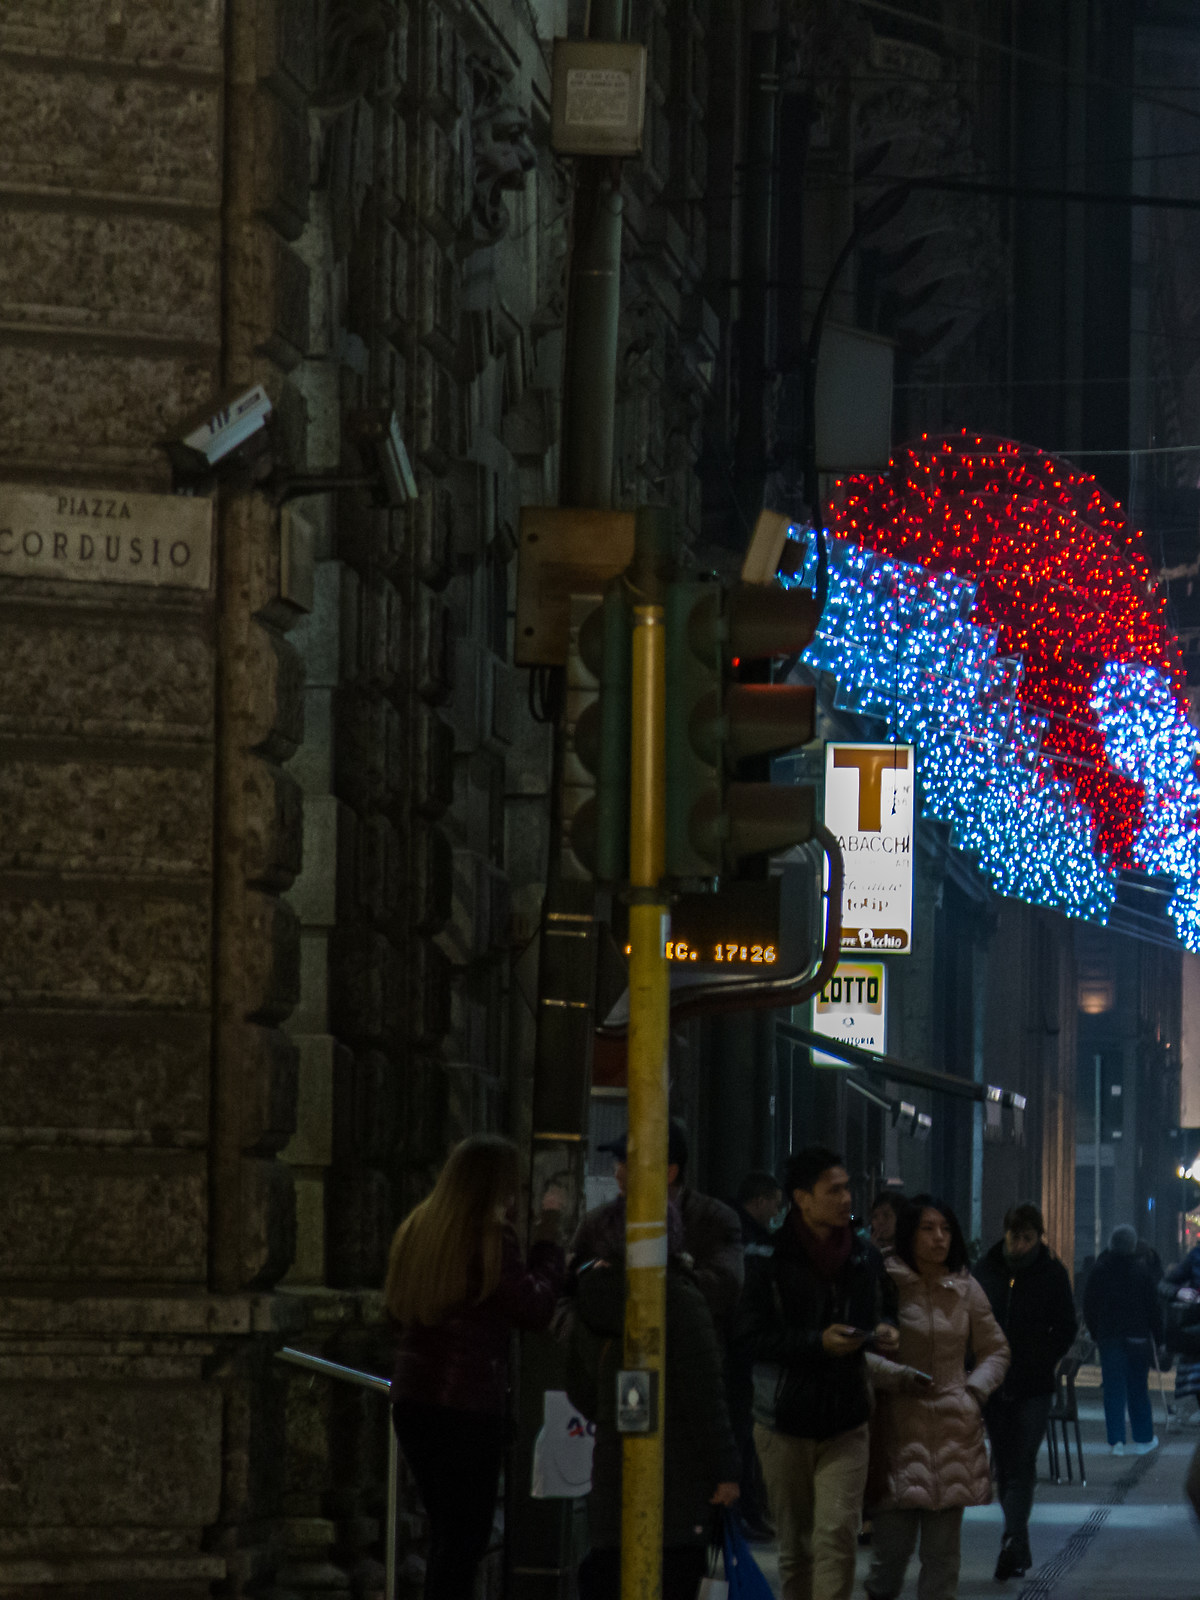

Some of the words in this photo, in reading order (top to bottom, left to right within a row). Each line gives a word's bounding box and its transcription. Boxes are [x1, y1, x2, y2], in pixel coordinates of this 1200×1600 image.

[58, 497, 132, 519] PIAZZA
[0, 528, 191, 567] CORDUSIO
[833, 748, 908, 832] T
[836, 834, 910, 854] ABACCHI
[858, 928, 902, 948] Picchio
[714, 944, 776, 963] 17:26
[820, 976, 879, 1004] LOTTO
